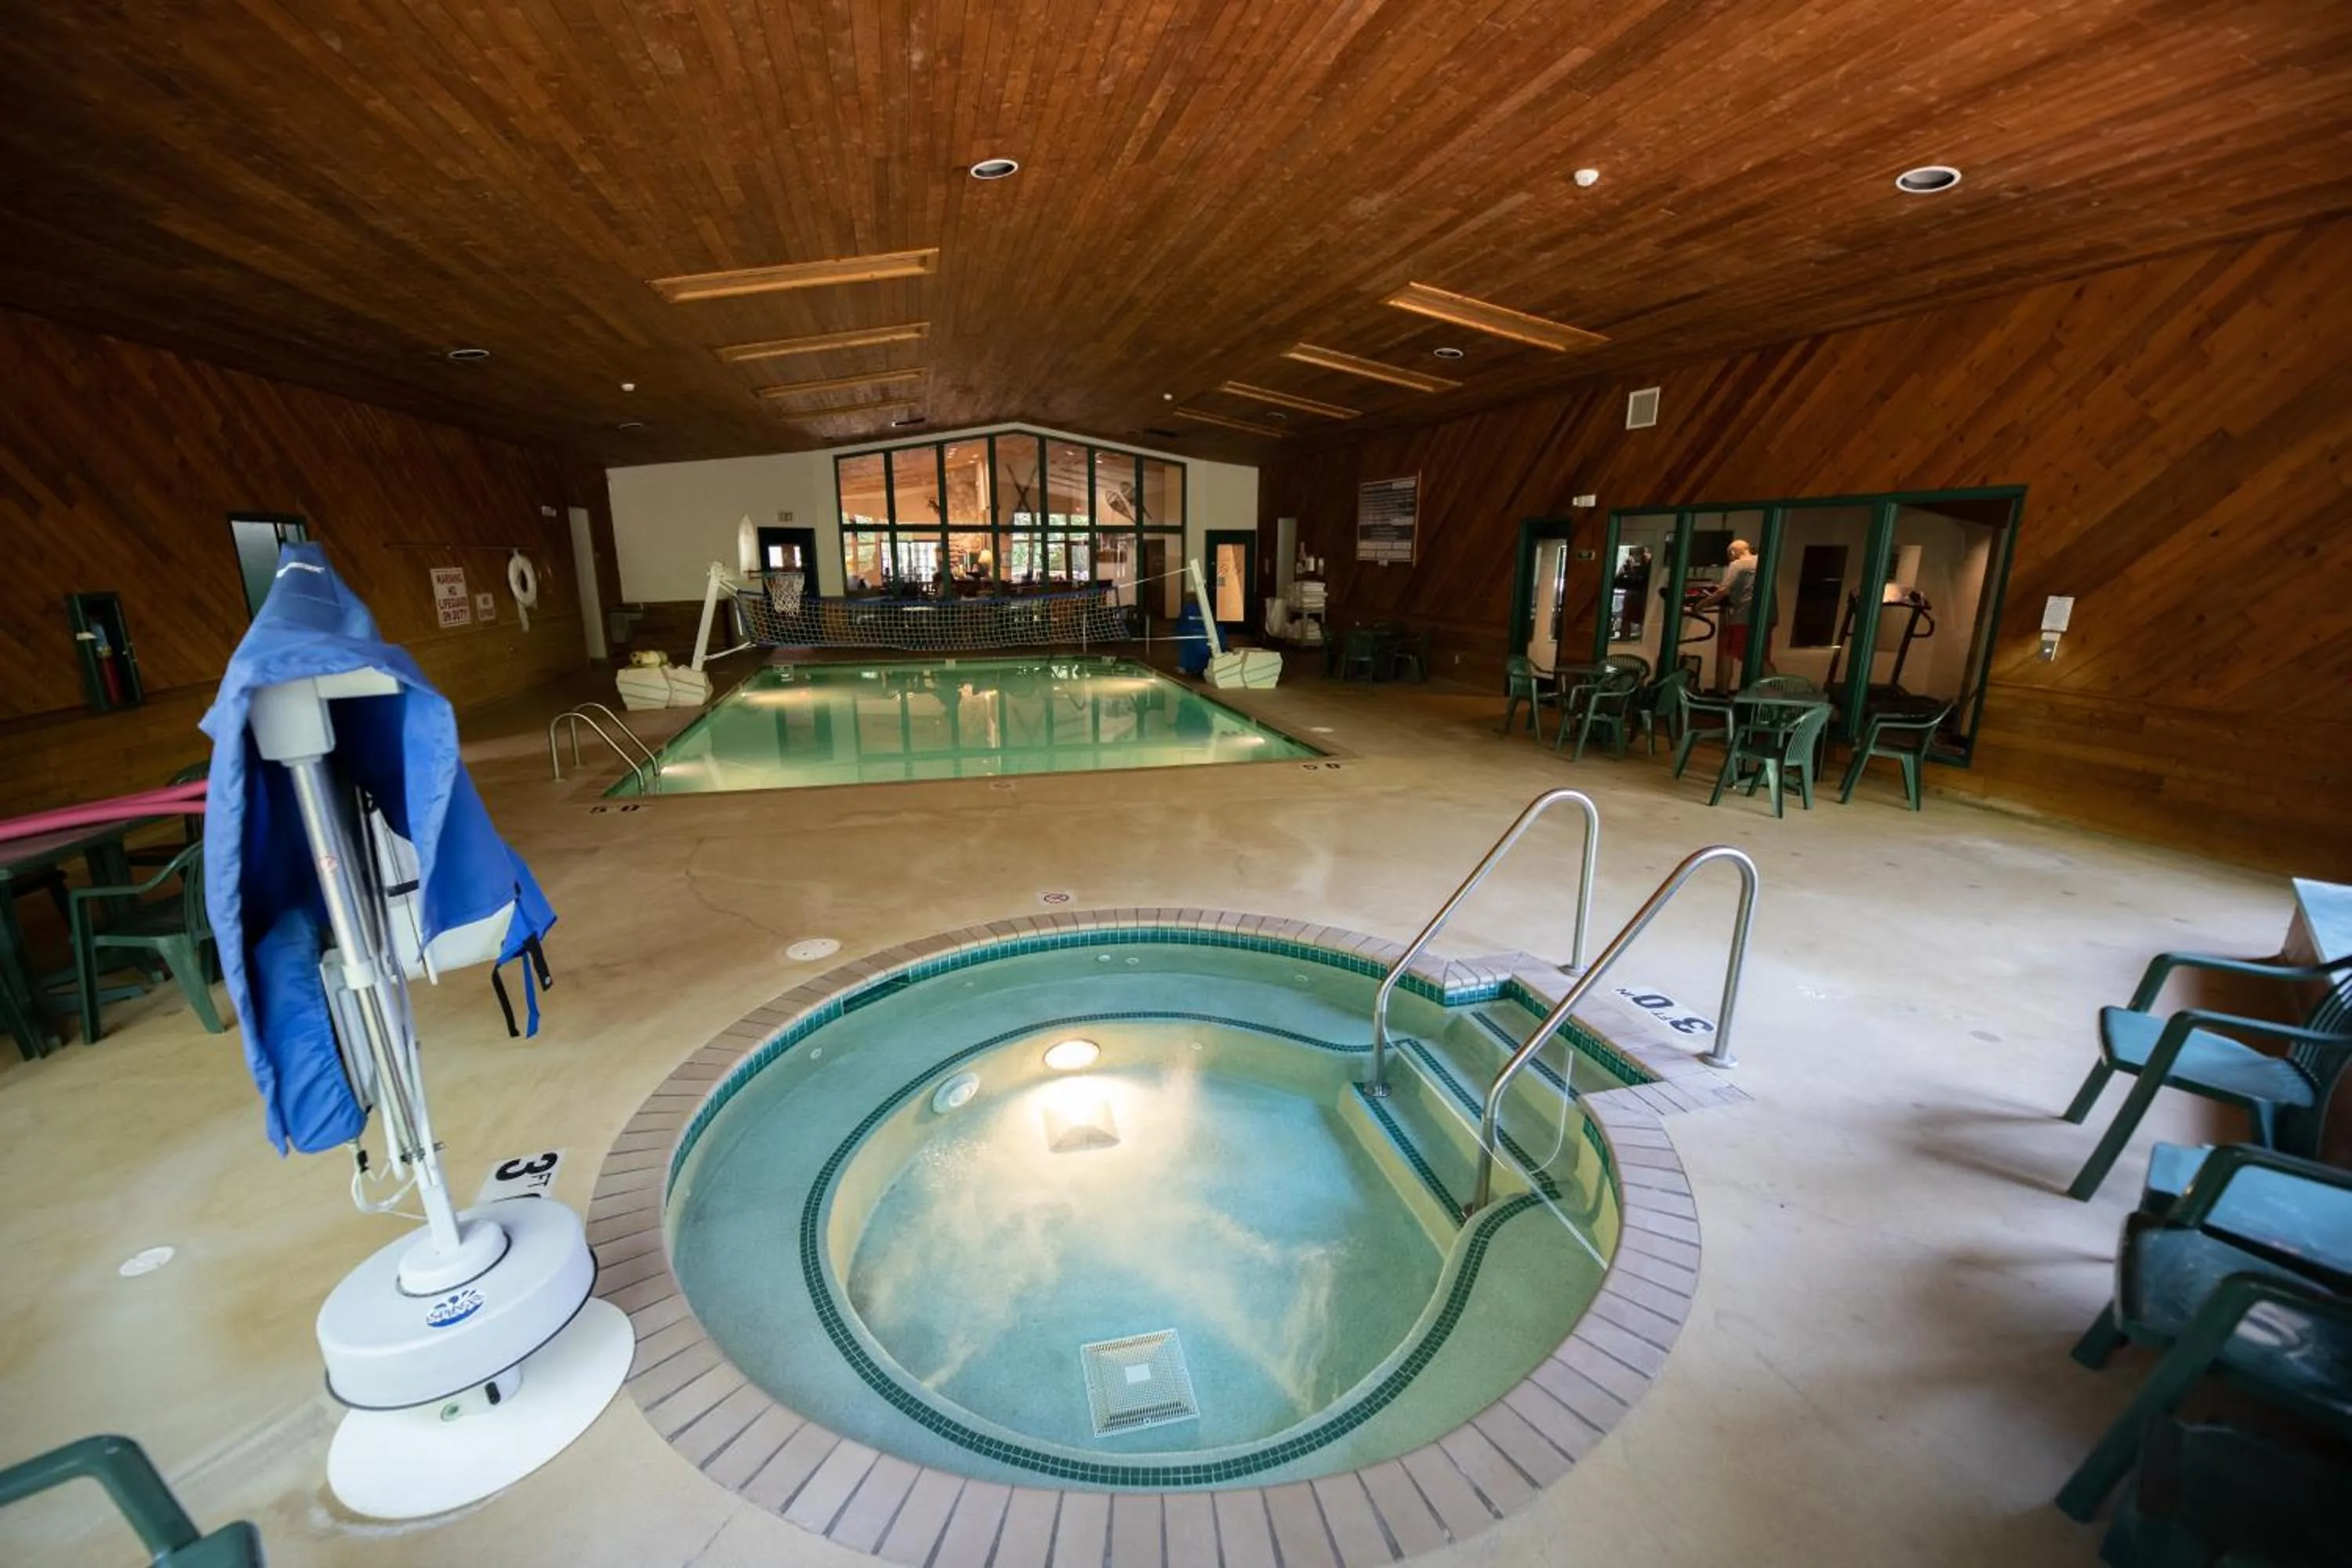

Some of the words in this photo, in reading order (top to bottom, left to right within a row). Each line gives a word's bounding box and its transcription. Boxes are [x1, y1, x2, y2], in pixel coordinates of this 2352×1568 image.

[436, 572, 463, 585] WARNING
[448, 586, 457, 596] NO
[438, 596, 468, 609] LIFEGUARD
[443, 611, 452, 622] ON
[452, 608, 468, 621] DUTY
[1669, 1017, 1715, 1033] 3
[495, 1152, 558, 1181] 3
[527, 1172, 552, 1188] FT
